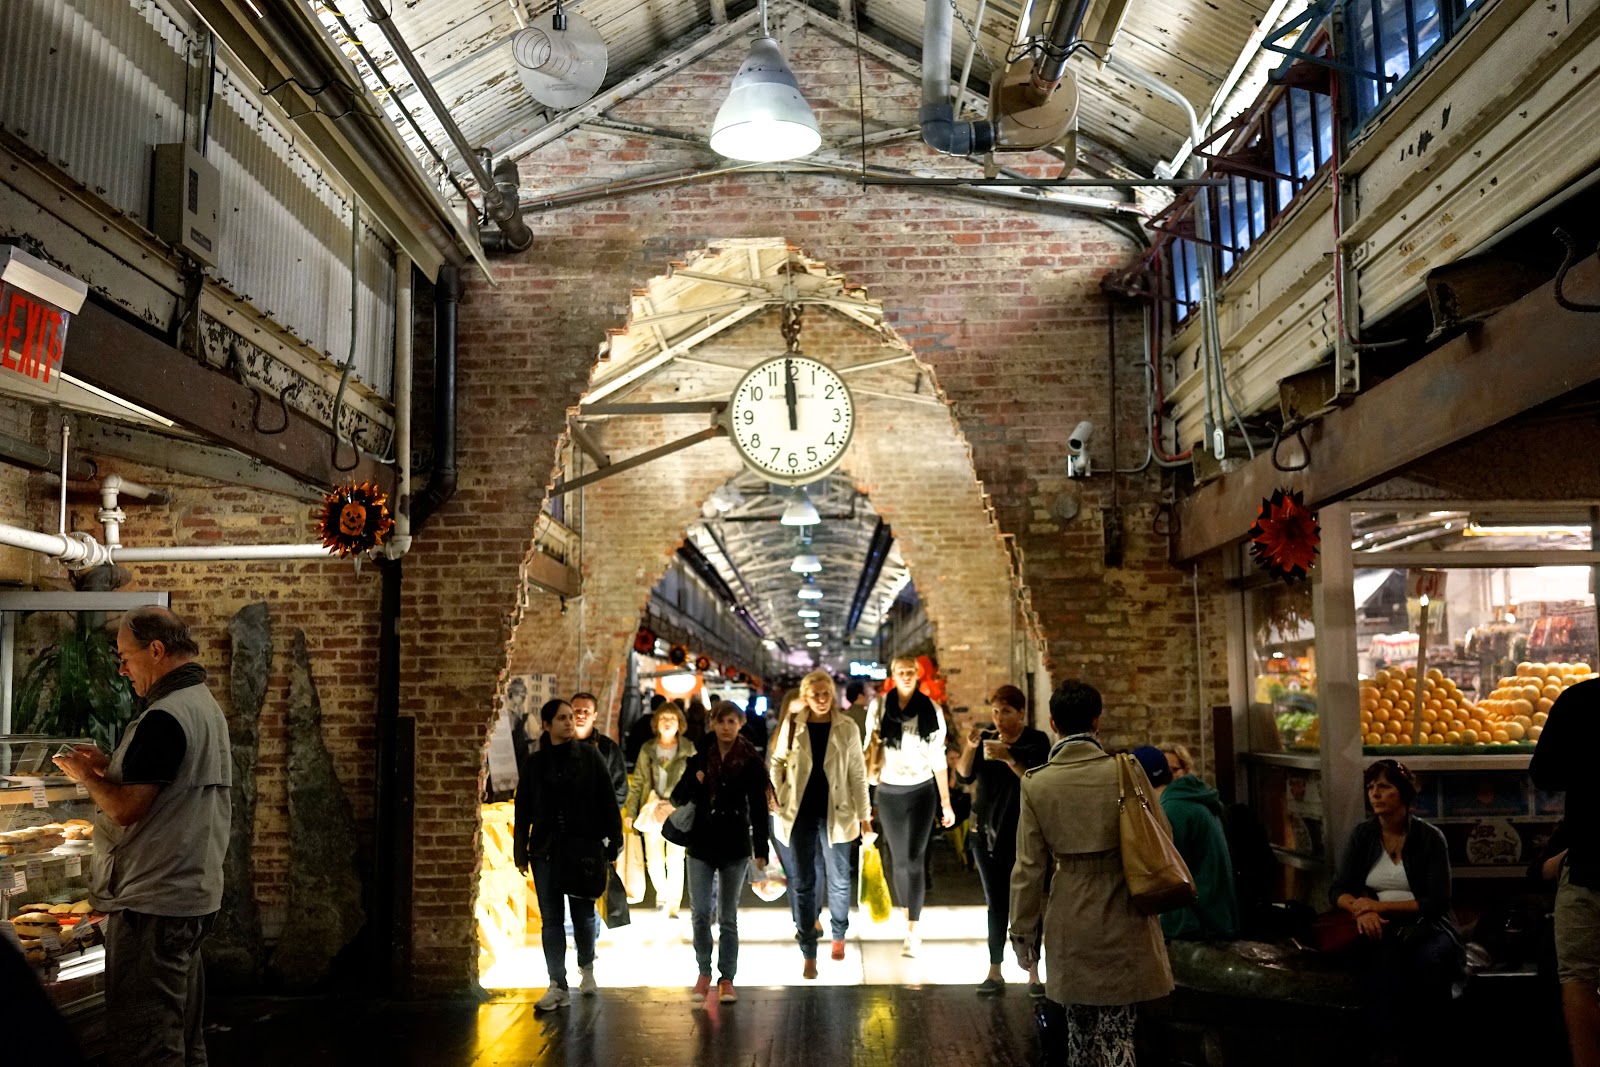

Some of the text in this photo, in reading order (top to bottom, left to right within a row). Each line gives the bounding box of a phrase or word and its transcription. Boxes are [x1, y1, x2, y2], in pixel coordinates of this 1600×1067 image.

[3, 293, 62, 383] EXIT
[768, 371, 777, 387] 11
[750, 386, 763, 401] 10
[824, 384, 835, 400] 2
[743, 410, 754, 425] 9
[832, 408, 842, 423] 3
[750, 433, 761, 448] 8
[824, 432, 836, 447] 4
[770, 447, 781, 463] 7
[788, 453, 798, 468] 6
[806, 446, 818, 462] 5
